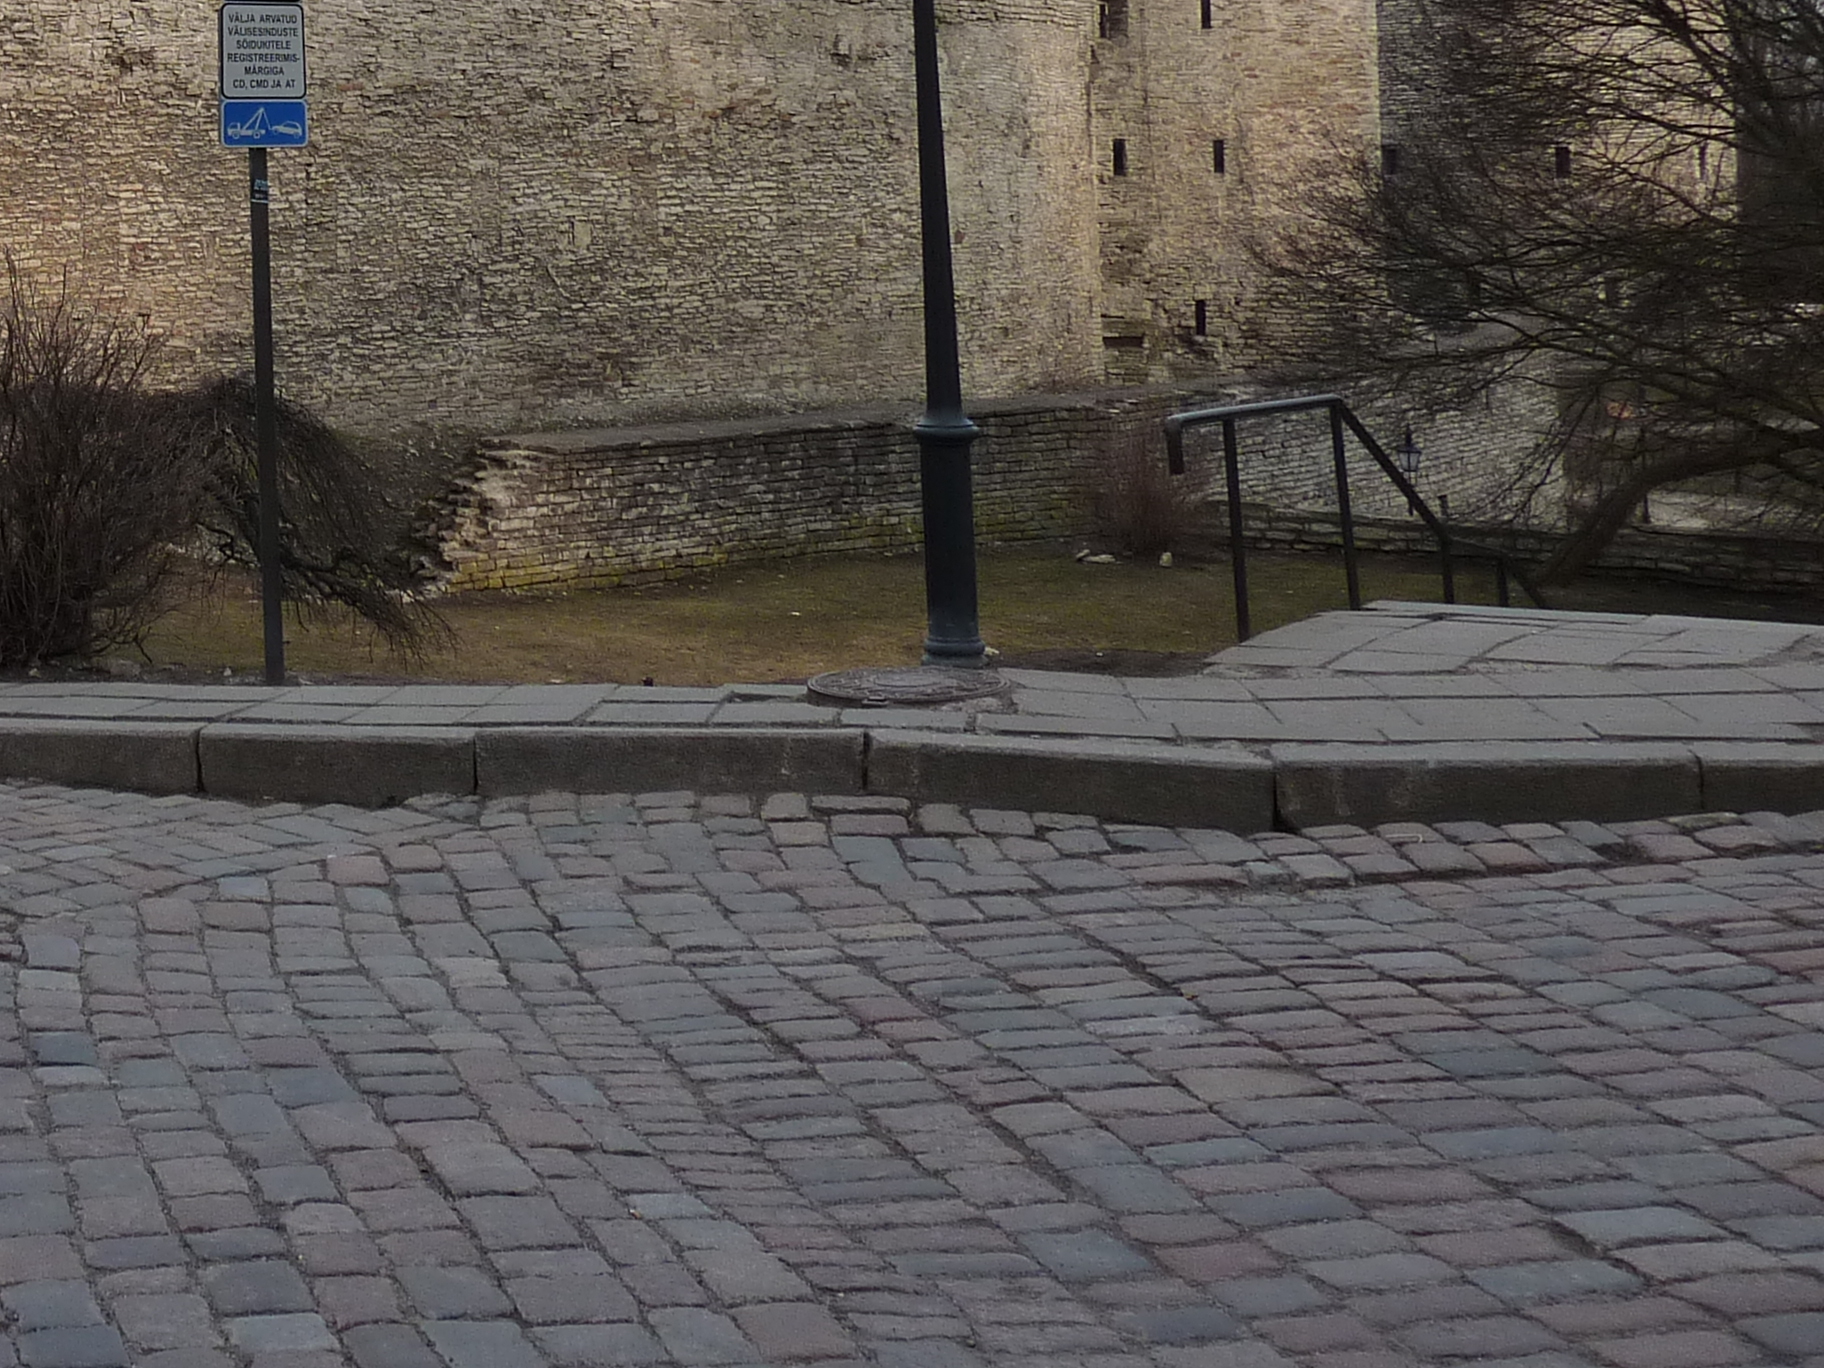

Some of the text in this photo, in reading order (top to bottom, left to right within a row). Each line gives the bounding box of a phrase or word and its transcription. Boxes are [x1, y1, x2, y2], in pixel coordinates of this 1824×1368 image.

[228, 12, 298, 24] VÄLJA ARVATUD
[227, 25, 299, 37] VÄLISESINDUSTE
[236, 38, 291, 50] SÕIDUKITELE
[227, 52, 301, 63] REGISTREERIMIS-
[244, 64, 285, 76] MÄRGIGA
[232, 78, 296, 90] CD, CMD JA AT
